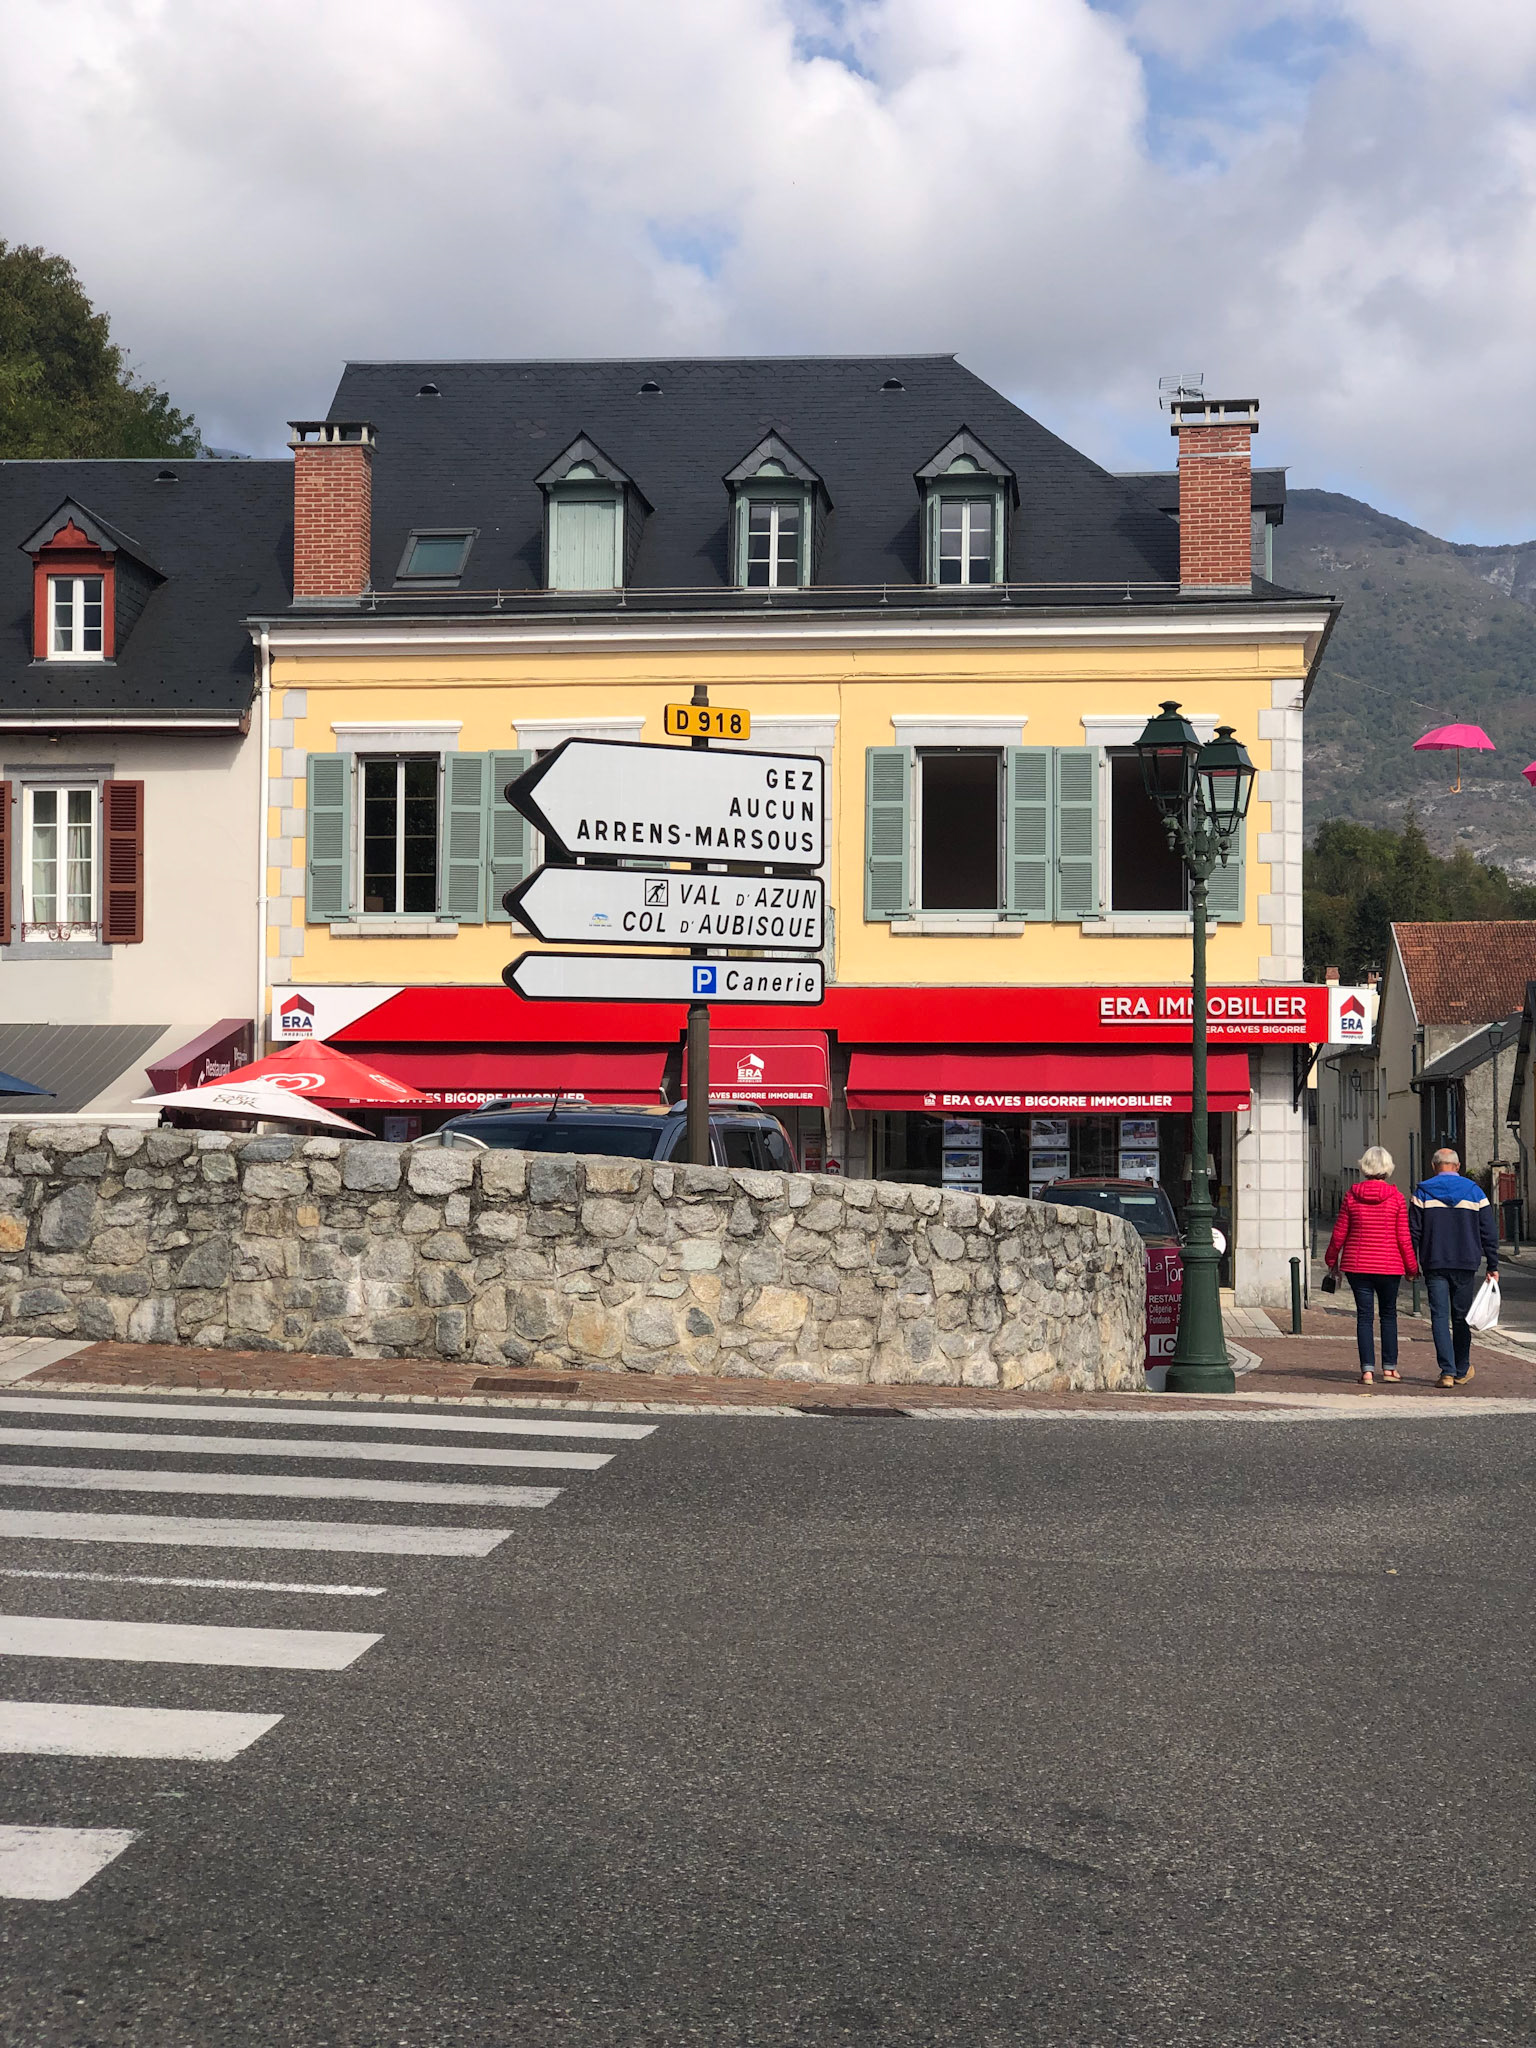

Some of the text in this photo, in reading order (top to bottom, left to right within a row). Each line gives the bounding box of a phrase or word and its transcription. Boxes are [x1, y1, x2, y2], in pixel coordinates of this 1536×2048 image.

[677, 710, 741, 733] D 918
[767, 769, 812, 790] GEZ
[730, 798, 812, 821] AUCUN
[577, 820, 812, 851] ARRENS-MARSOUS
[681, 884, 719, 905] VAL
[623, 912, 665, 932] COL
[727, 971, 814, 992] Canerie
[1101, 997, 1150, 1015] ERA
[282, 1016, 312, 1028] ERA
[1341, 1018, 1363, 1030] ERA
[738, 1069, 762, 1077] ERA
[943, 1095, 970, 1105] ERA
[975, 1096, 1021, 1106] GAVES
[1025, 1096, 1086, 1106] BIGORRE
[1091, 1096, 1172, 1106] IMMOBILIER
[1148, 1256, 1163, 1273] La
